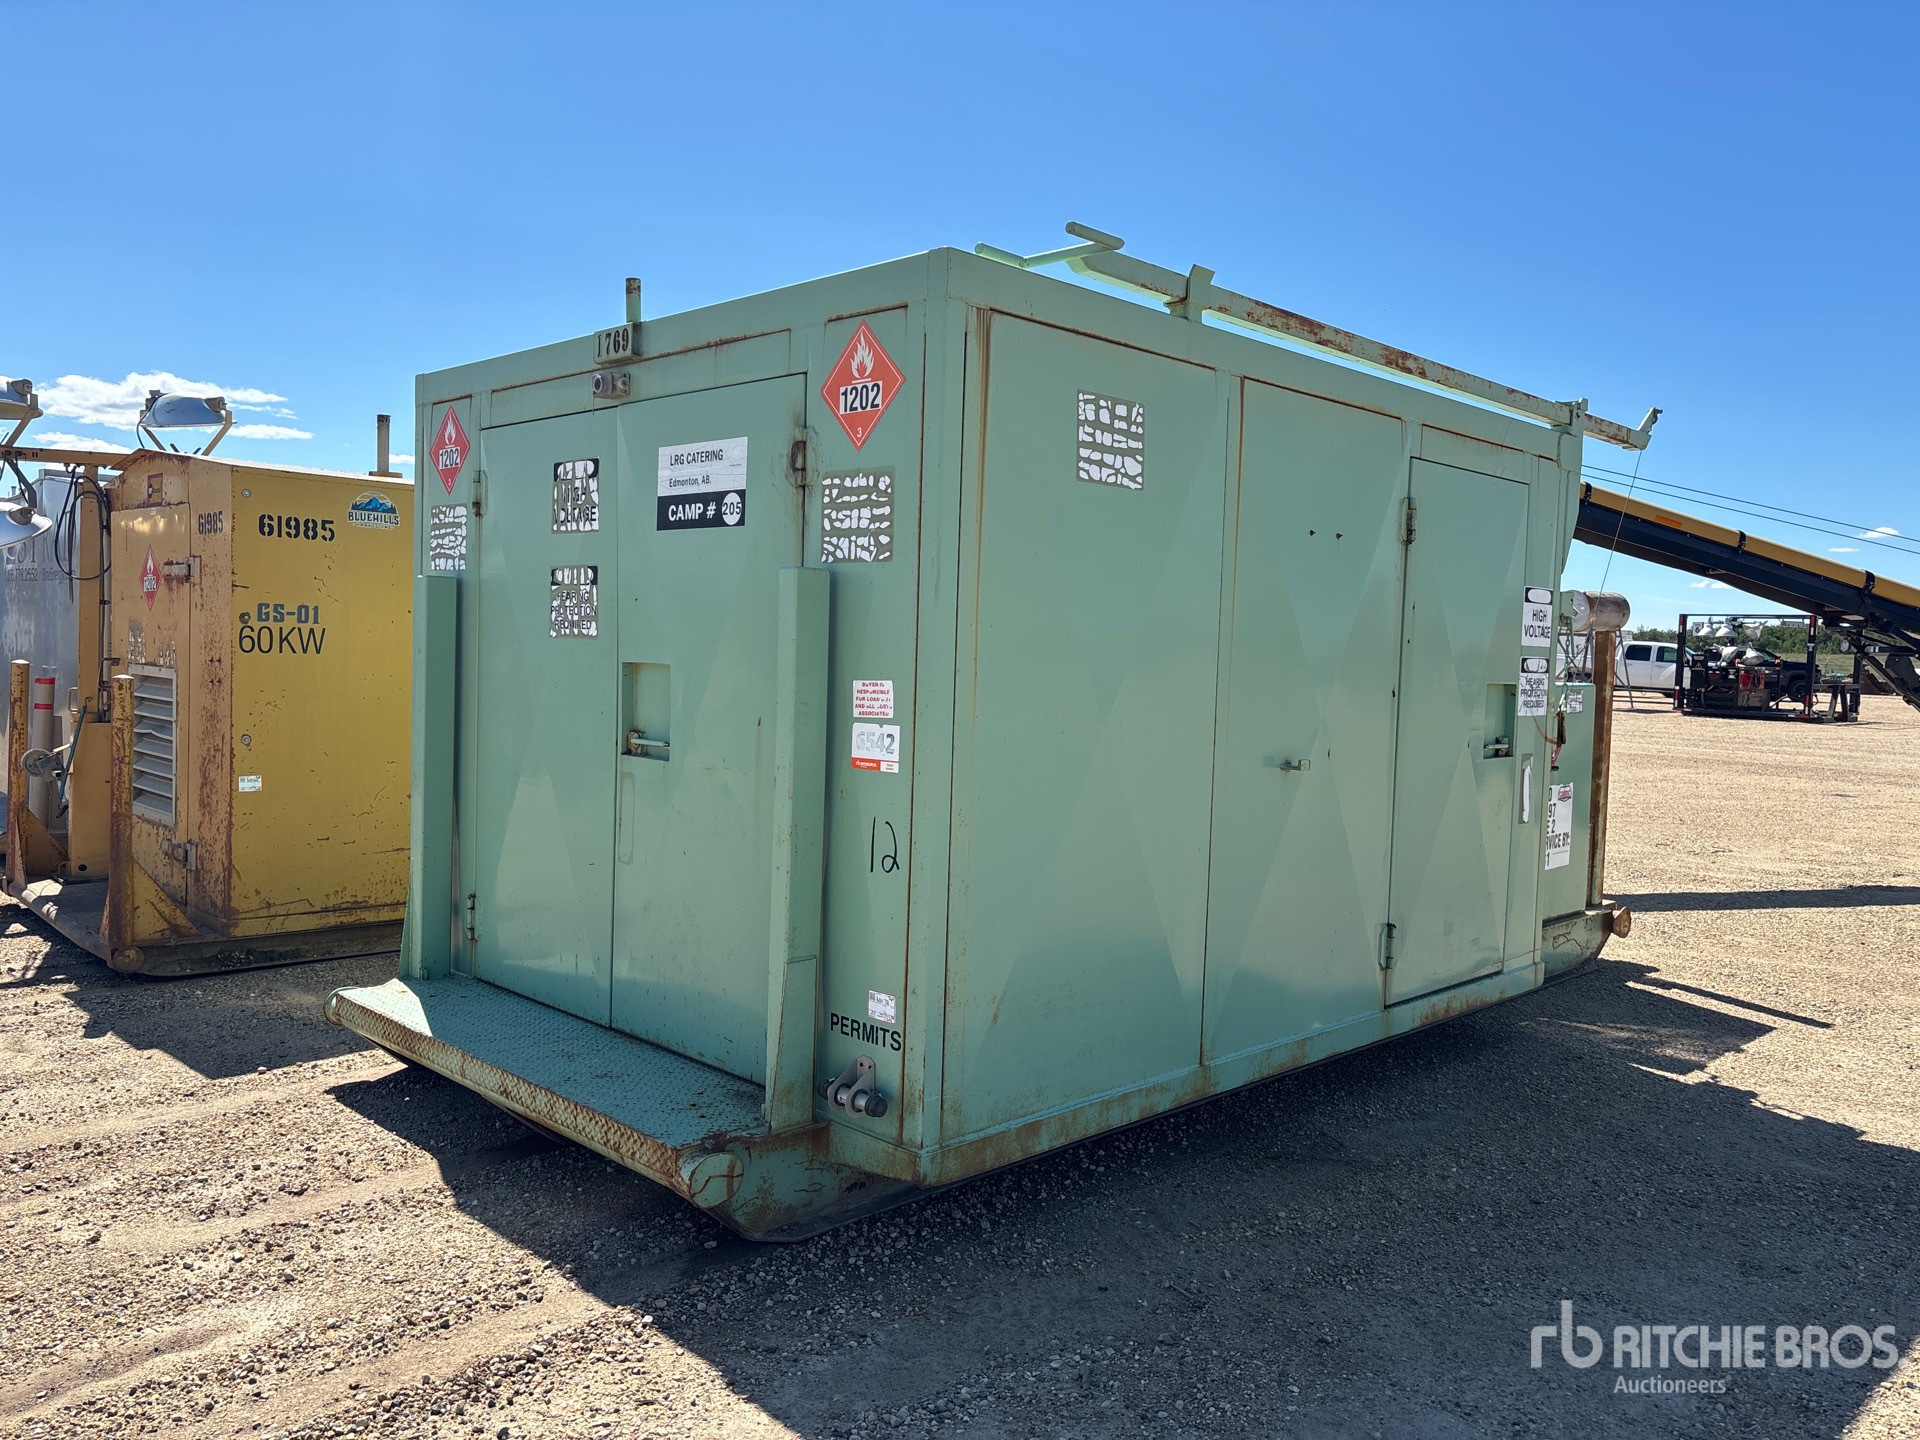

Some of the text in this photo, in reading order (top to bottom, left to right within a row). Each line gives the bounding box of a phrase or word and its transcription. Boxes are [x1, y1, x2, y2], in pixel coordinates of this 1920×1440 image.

[597, 328, 630, 358] 1769
[840, 382, 881, 413] 1202
[856, 427, 862, 438] 3
[439, 448, 460, 469] 1202
[670, 449, 724, 467] LRG CATERING
[669, 476, 700, 488] Edmonton,
[348, 511, 400, 526] BLUEHILLS
[668, 501, 742, 522] CAMP # 205
[198, 510, 224, 535] 61985
[258, 513, 335, 542] 61985
[557, 589, 590, 602] EARNG
[256, 602, 321, 625] GS-01
[1531, 608, 1548, 623] HIGH
[1524, 624, 1551, 639] VOLTAGE
[855, 731, 895, 754] 6542
[870, 816, 900, 873] 12
[830, 1012, 902, 1052] PERMITS
